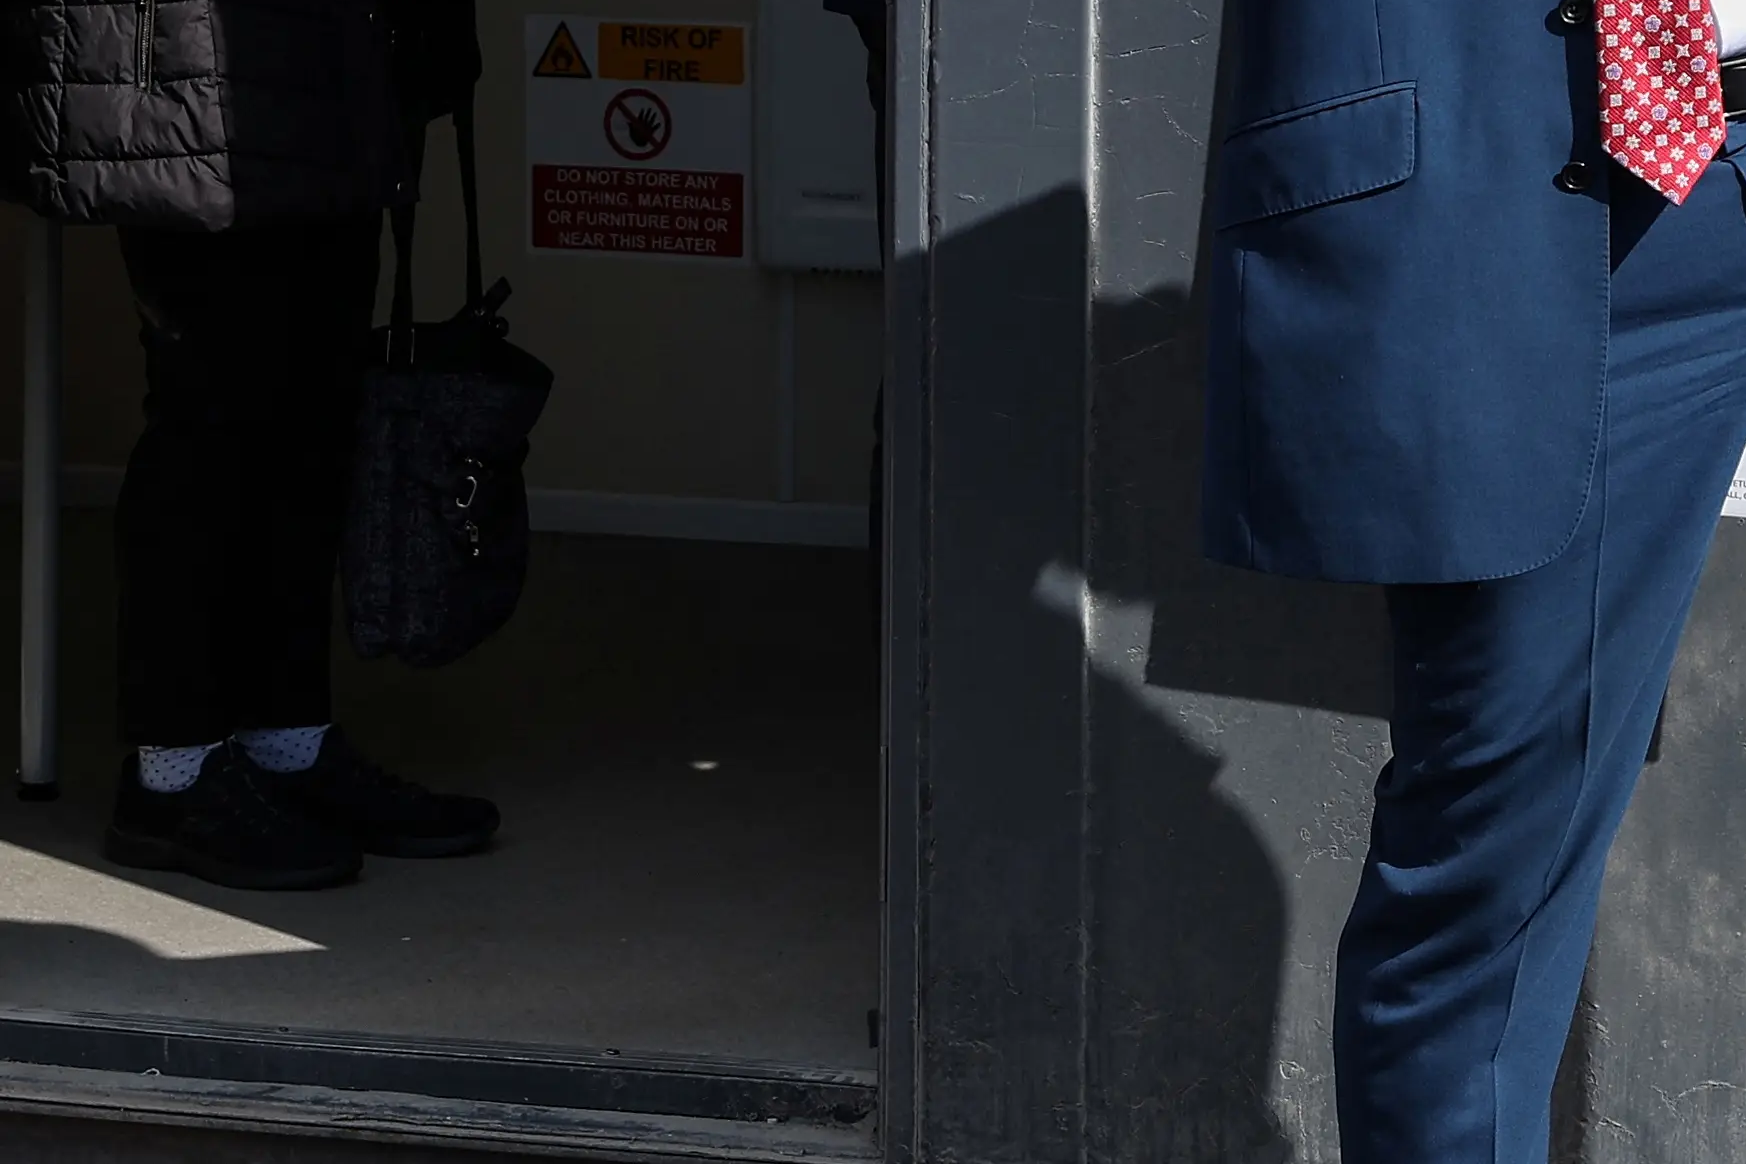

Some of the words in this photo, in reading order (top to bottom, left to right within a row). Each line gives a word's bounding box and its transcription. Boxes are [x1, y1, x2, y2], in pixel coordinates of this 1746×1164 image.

[621, 26, 678, 49] RISK
[688, 28, 722, 49] OF
[644, 59, 699, 81] FIRE
[557, 168, 581, 183] DO
[586, 170, 619, 185] NOT
[625, 172, 680, 188] STORE
[684, 175, 719, 190] ANY
[638, 193, 731, 211] MATERIALS
[548, 210, 571, 224] OR
[576, 211, 670, 229] FURNITURE
[675, 215, 699, 231] ON
[704, 217, 728, 232] OR
[560, 232, 605, 247] NEAR
[610, 233, 646, 248] THIS
[652, 236, 716, 252] HEATER
